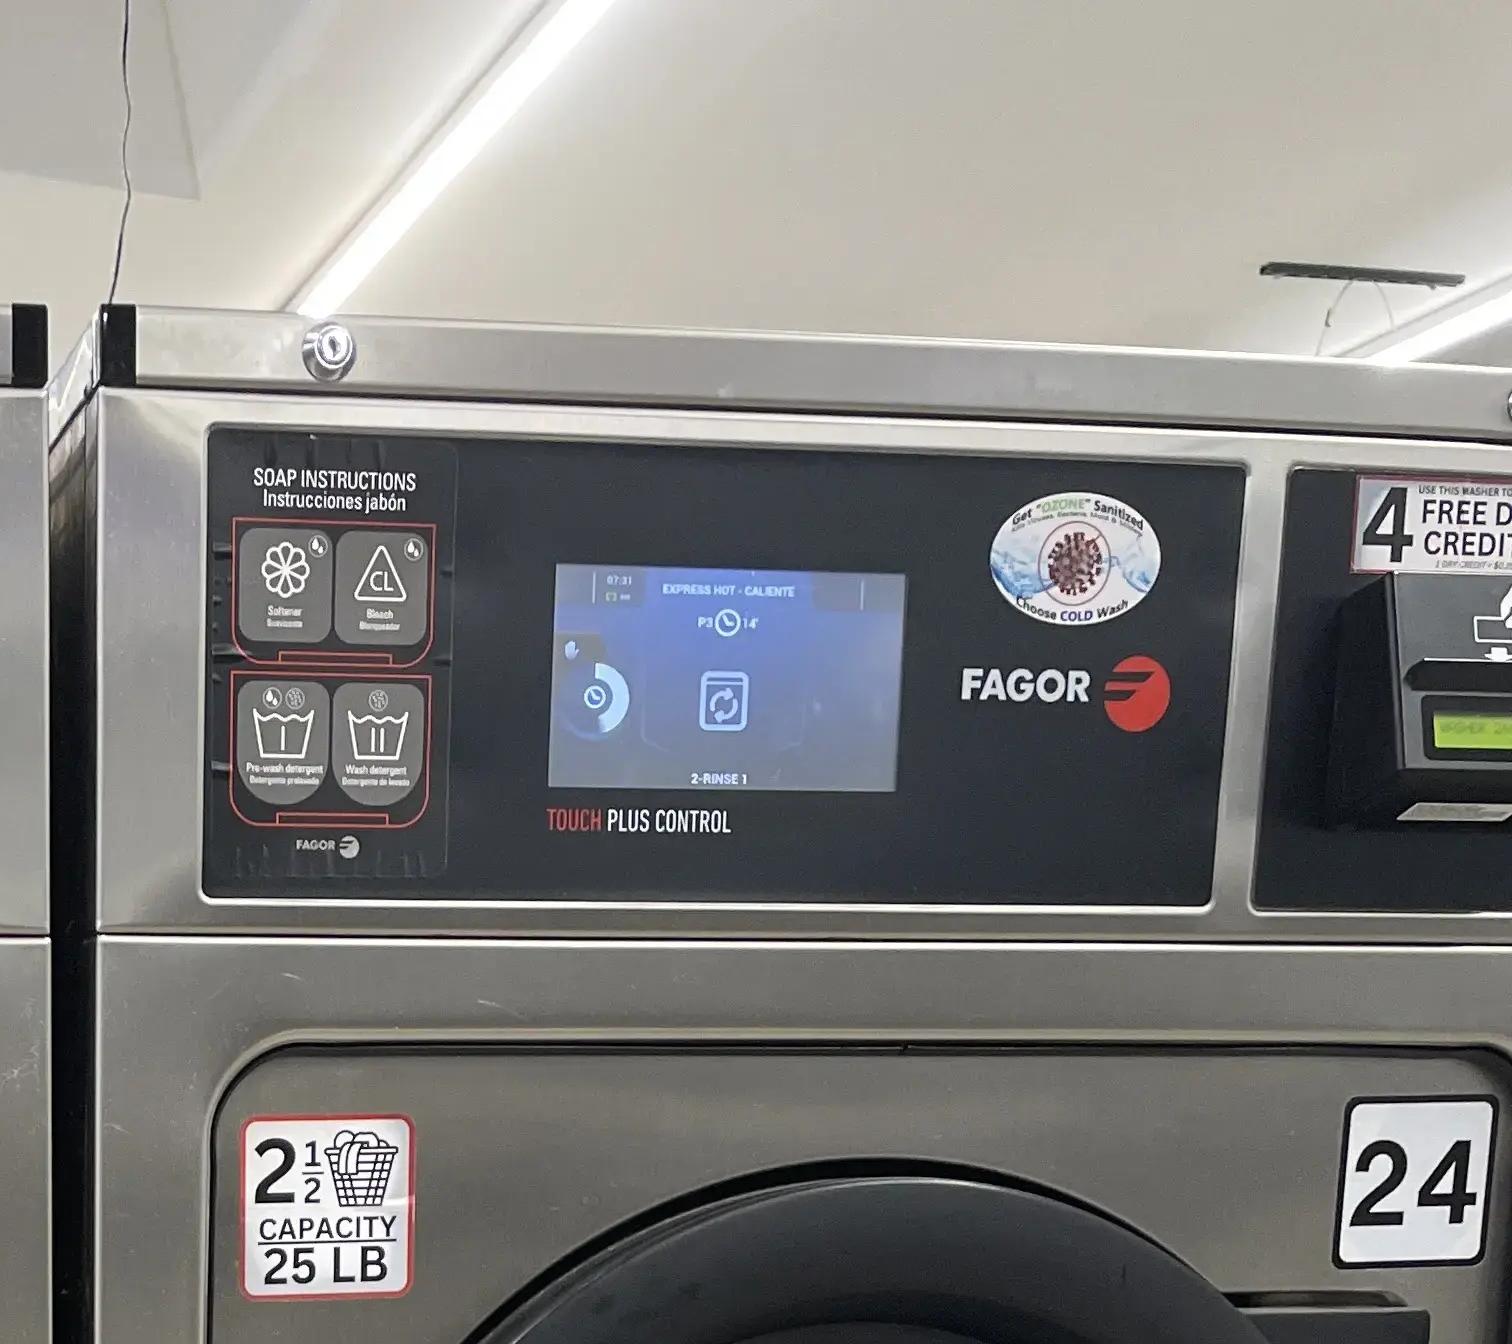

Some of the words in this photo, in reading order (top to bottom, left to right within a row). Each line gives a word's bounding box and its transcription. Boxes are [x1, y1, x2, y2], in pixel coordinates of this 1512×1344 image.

[253, 468, 297, 487] SOAP
[301, 469, 417, 492] INSTRUCTIONS
[1419, 485, 1436, 495] USE
[1439, 486, 1460, 496] THIS
[1462, 487, 1499, 497] WASHER
[263, 489, 363, 510] Instrucciones
[364, 493, 406, 514] jabón
[1422, 499, 1487, 525] FREE
[1012, 509, 1033, 525] Get
[1093, 500, 1144, 531] Sanitized
[1361, 486, 1414, 563] 4
[662, 583, 711, 597] EXPRESS
[713, 585, 736, 598] HOT
[744, 585, 795, 599] CALIENTE
[1016, 596, 1057, 621] Choose
[1060, 610, 1093, 622] COLD
[1096, 599, 1129, 618] Wash
[697, 617, 713, 629] P3
[960, 667, 1091, 702] FAGOR
[285, 764, 324, 777] detergent
[346, 764, 369, 775] Wash
[369, 765, 407, 778] detergent
[691, 772, 739, 785] 2-RINSE
[742, 773, 748, 785] 1
[546, 807, 602, 832] TOUCH
[607, 808, 650, 833] PLUS
[655, 809, 732, 834] CONTROL
[296, 839, 336, 851] FAGOR
[254, 1137, 296, 1204] 2
[1349, 1139, 1477, 1227] 24
[259, 1215, 397, 1241] CAPACITY
[264, 1247, 316, 1285] 25
[333, 1245, 388, 1283] LB
